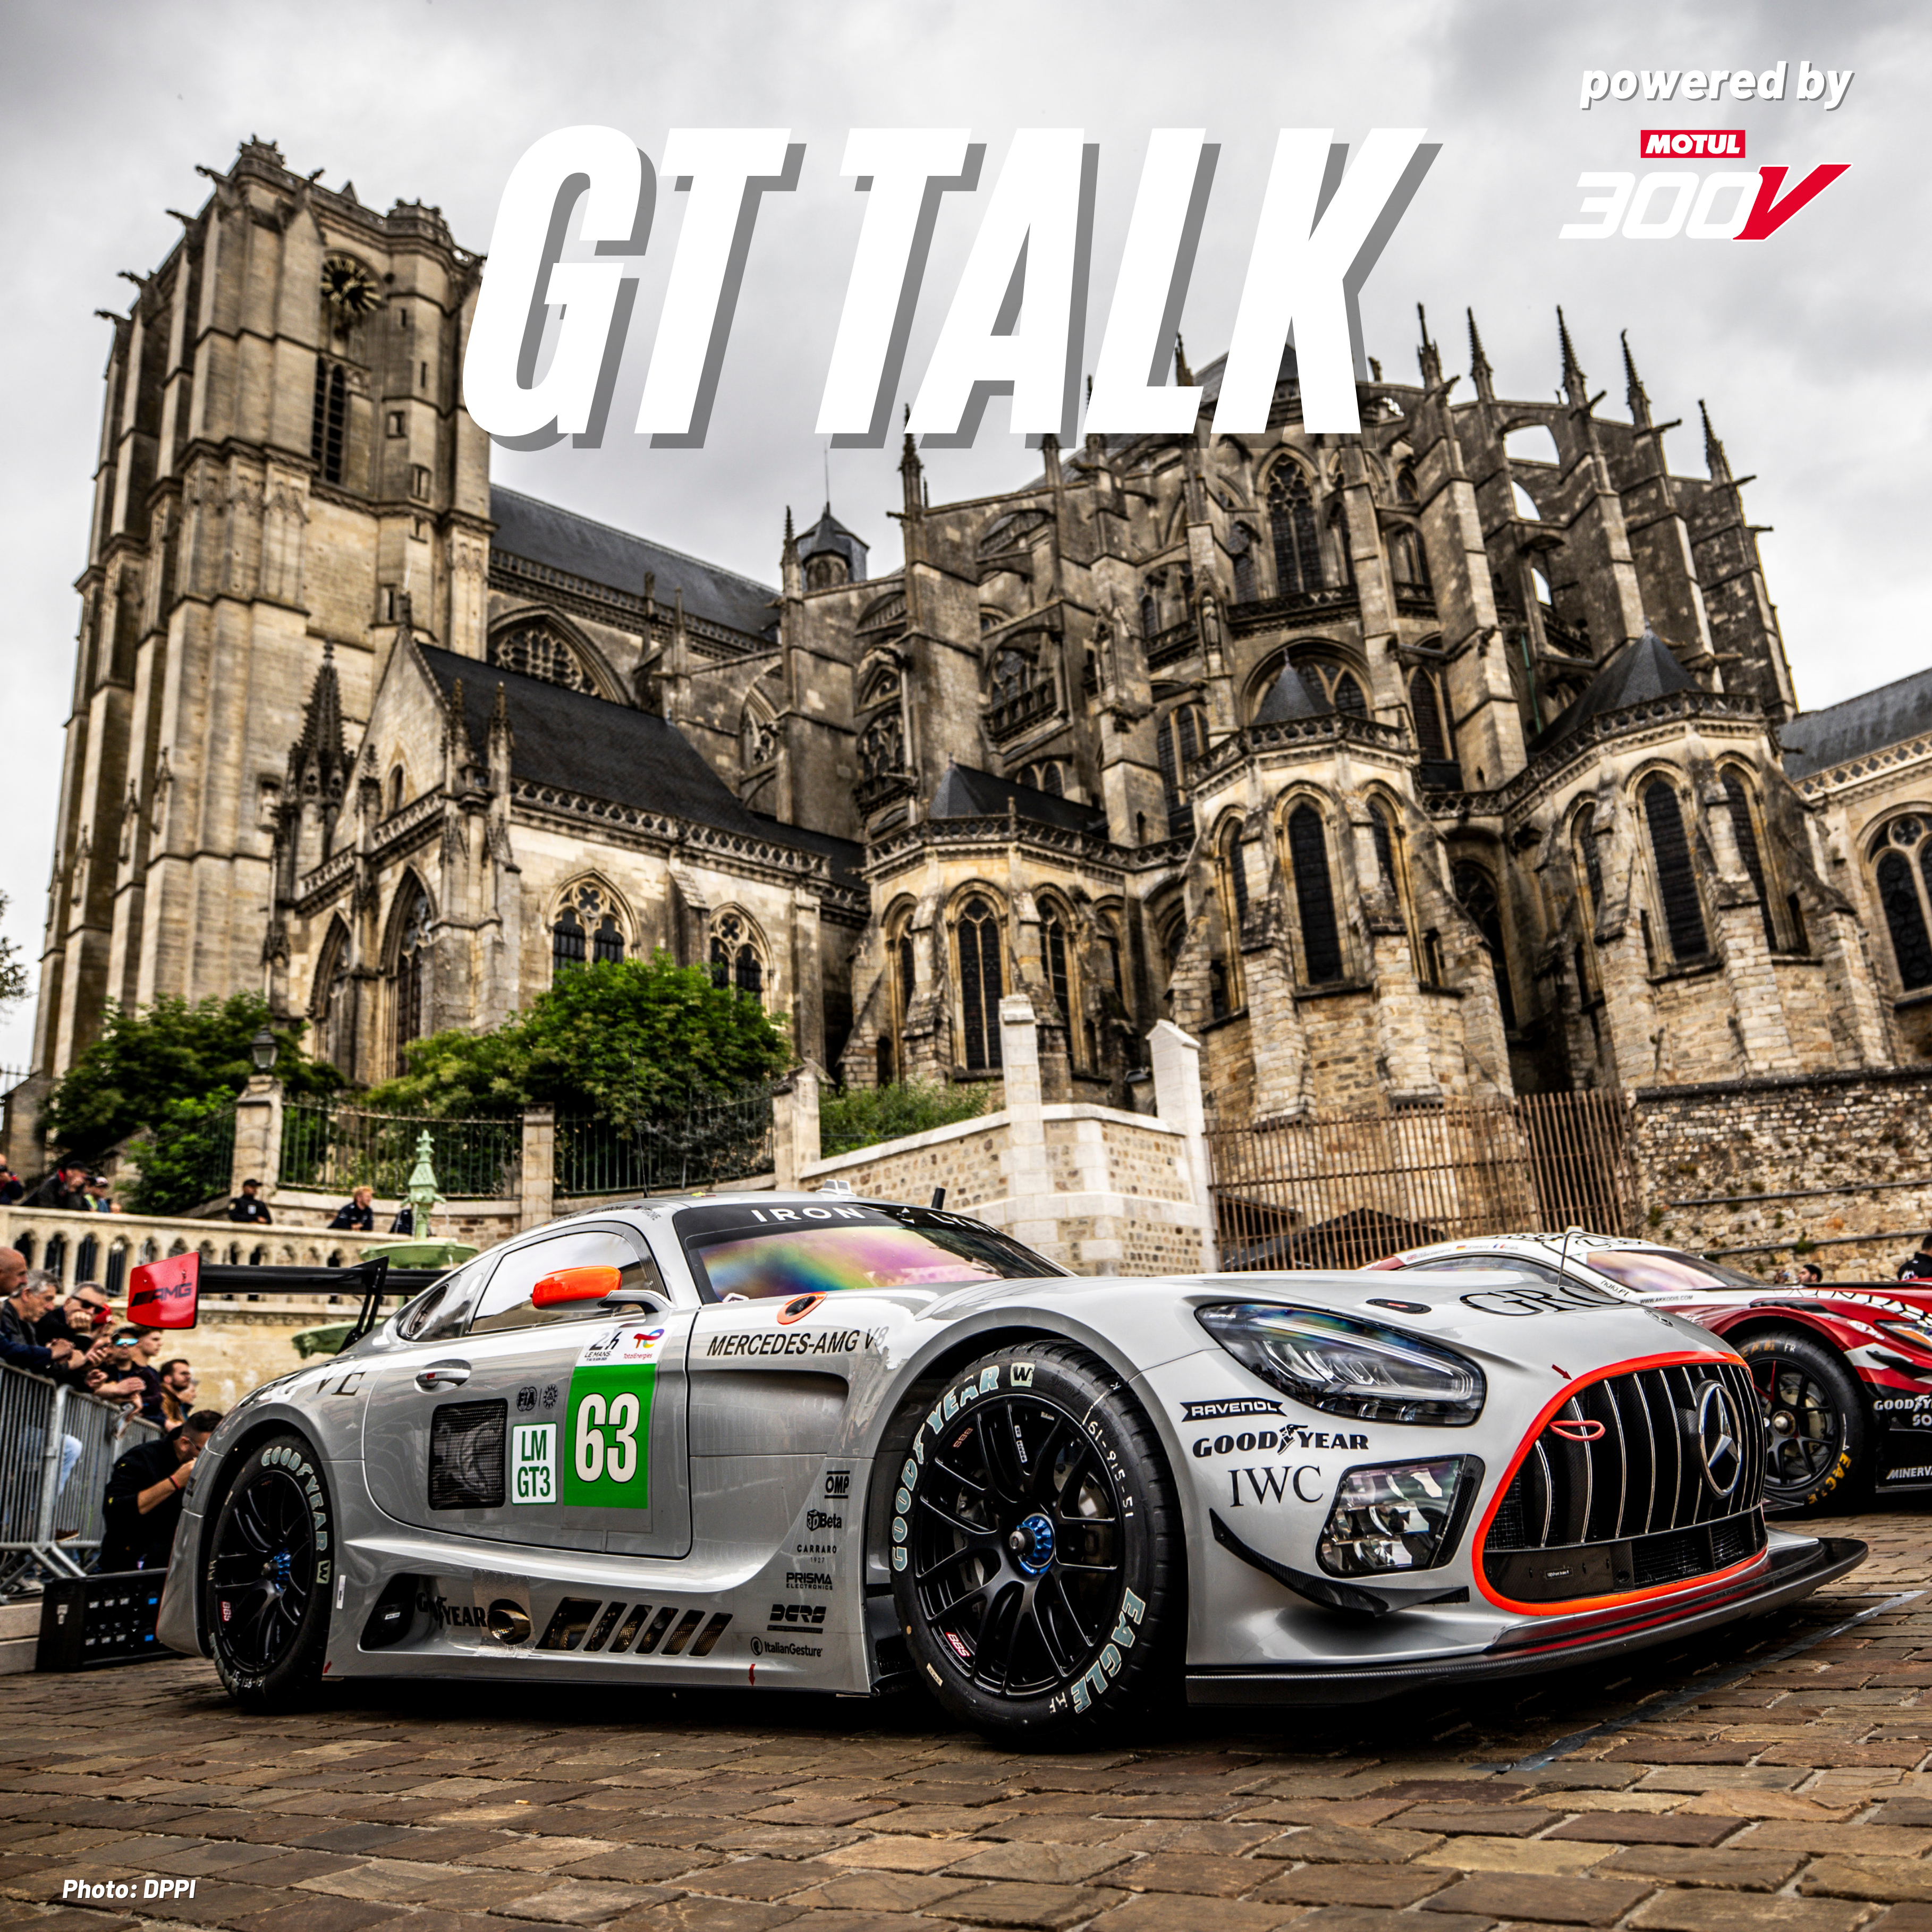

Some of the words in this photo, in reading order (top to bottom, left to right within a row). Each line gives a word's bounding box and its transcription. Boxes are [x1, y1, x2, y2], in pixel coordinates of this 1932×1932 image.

[751, 1207, 866, 1222] IRON
[152, 1282, 192, 1301] AMG
[1640, 1294, 1693, 1304] WWW.AKKODIS.COM
[707, 1329, 860, 1357] MERCEDES-AMG
[865, 1326, 889, 1350] V8
[1784, 1342, 1796, 1353] FR
[1013, 1366, 1032, 1383] W
[1191, 1401, 1277, 1417] RAVENOL
[1873, 1395, 1932, 1412] GOODY
[521, 1429, 547, 1462] LM
[574, 1392, 639, 1484] 63
[953, 1427, 973, 1448] BBS
[1192, 1424, 1369, 1458] GOODYEAR
[892, 1365, 1000, 1572] GOODYEAR
[1886, 1465, 1932, 1480] MINERV
[518, 1465, 551, 1498] GT3
[825, 1475, 850, 1494] OMP
[1227, 1465, 1324, 1507] IWC
[261, 1446, 328, 1551] GOODYEAR
[797, 1544, 837, 1554] CARRARO
[786, 1572, 833, 1585] PRISMA
[222, 1601, 232, 1622] BBS
[769, 1604, 827, 1624] DCRS
[764, 1641, 823, 1657] ItalianGesture
[947, 1633, 970, 1657] BBS
[1071, 1587, 1146, 1714] EAGLE
